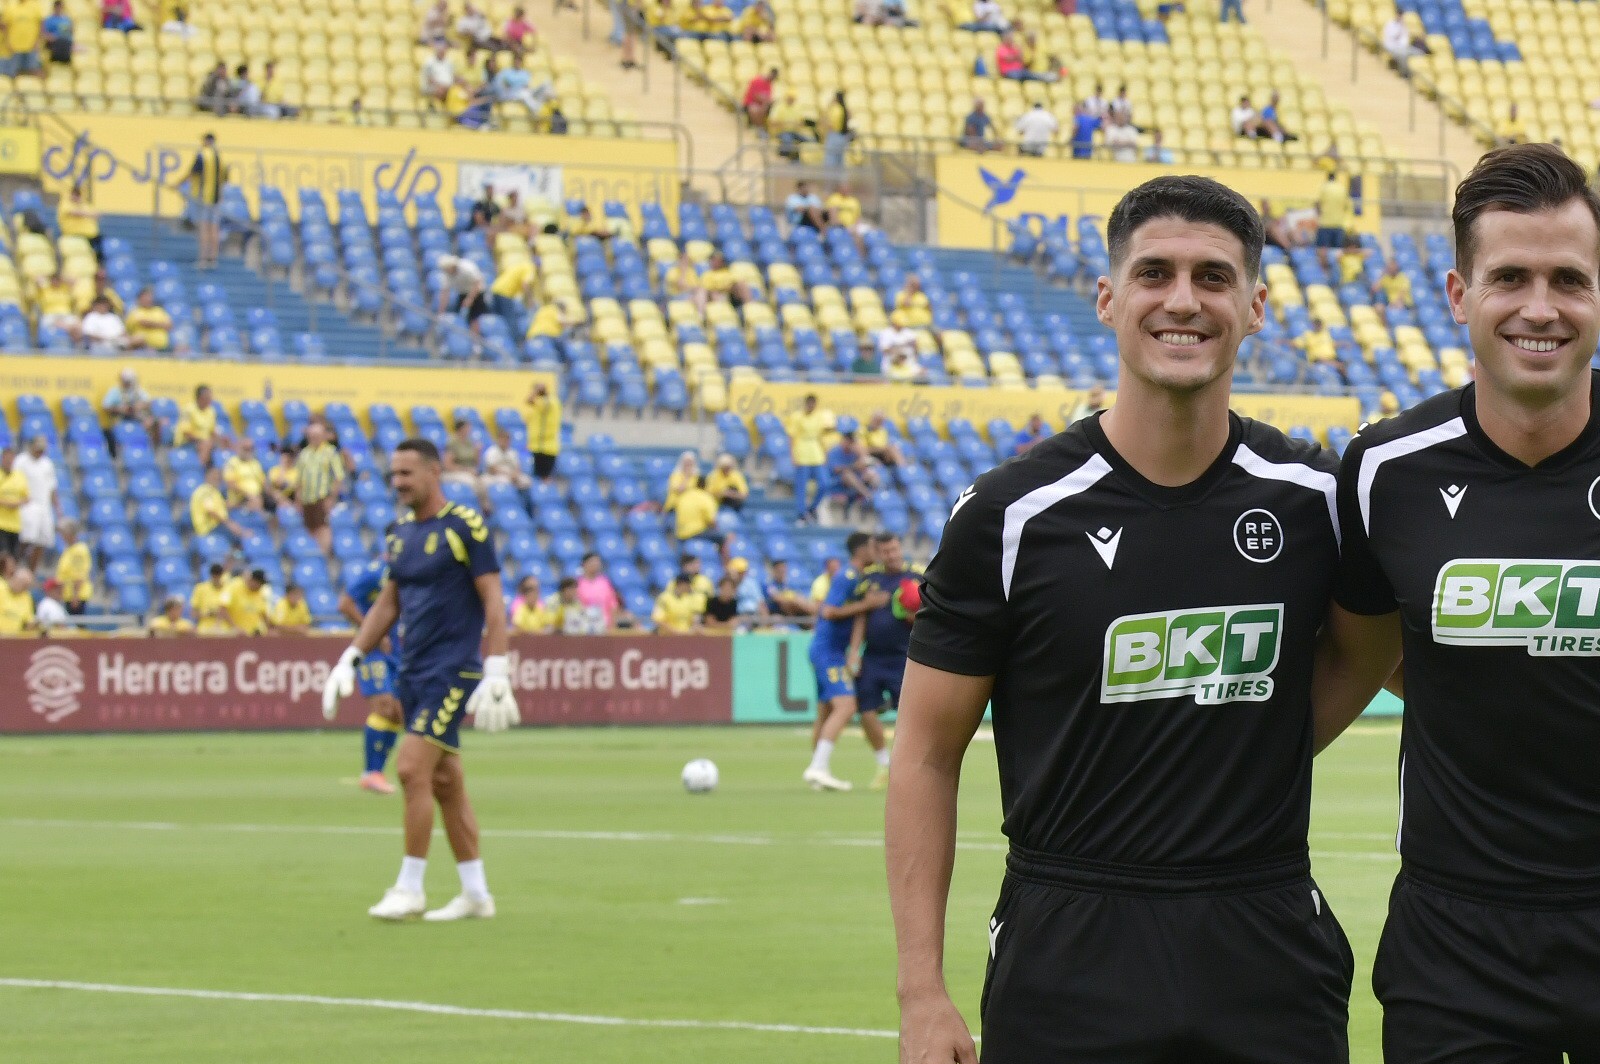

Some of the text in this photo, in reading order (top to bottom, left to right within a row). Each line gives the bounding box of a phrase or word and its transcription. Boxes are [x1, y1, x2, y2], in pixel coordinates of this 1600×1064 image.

[1245, 522, 1273, 535] RF
[1246, 537, 1274, 550] EF
[1113, 621, 1274, 675] BKT
[97, 651, 229, 696] Herrera
[233, 650, 332, 703] Cerpa
[620, 649, 710, 698] Cerpa
[1201, 680, 1269, 700] TIRES
